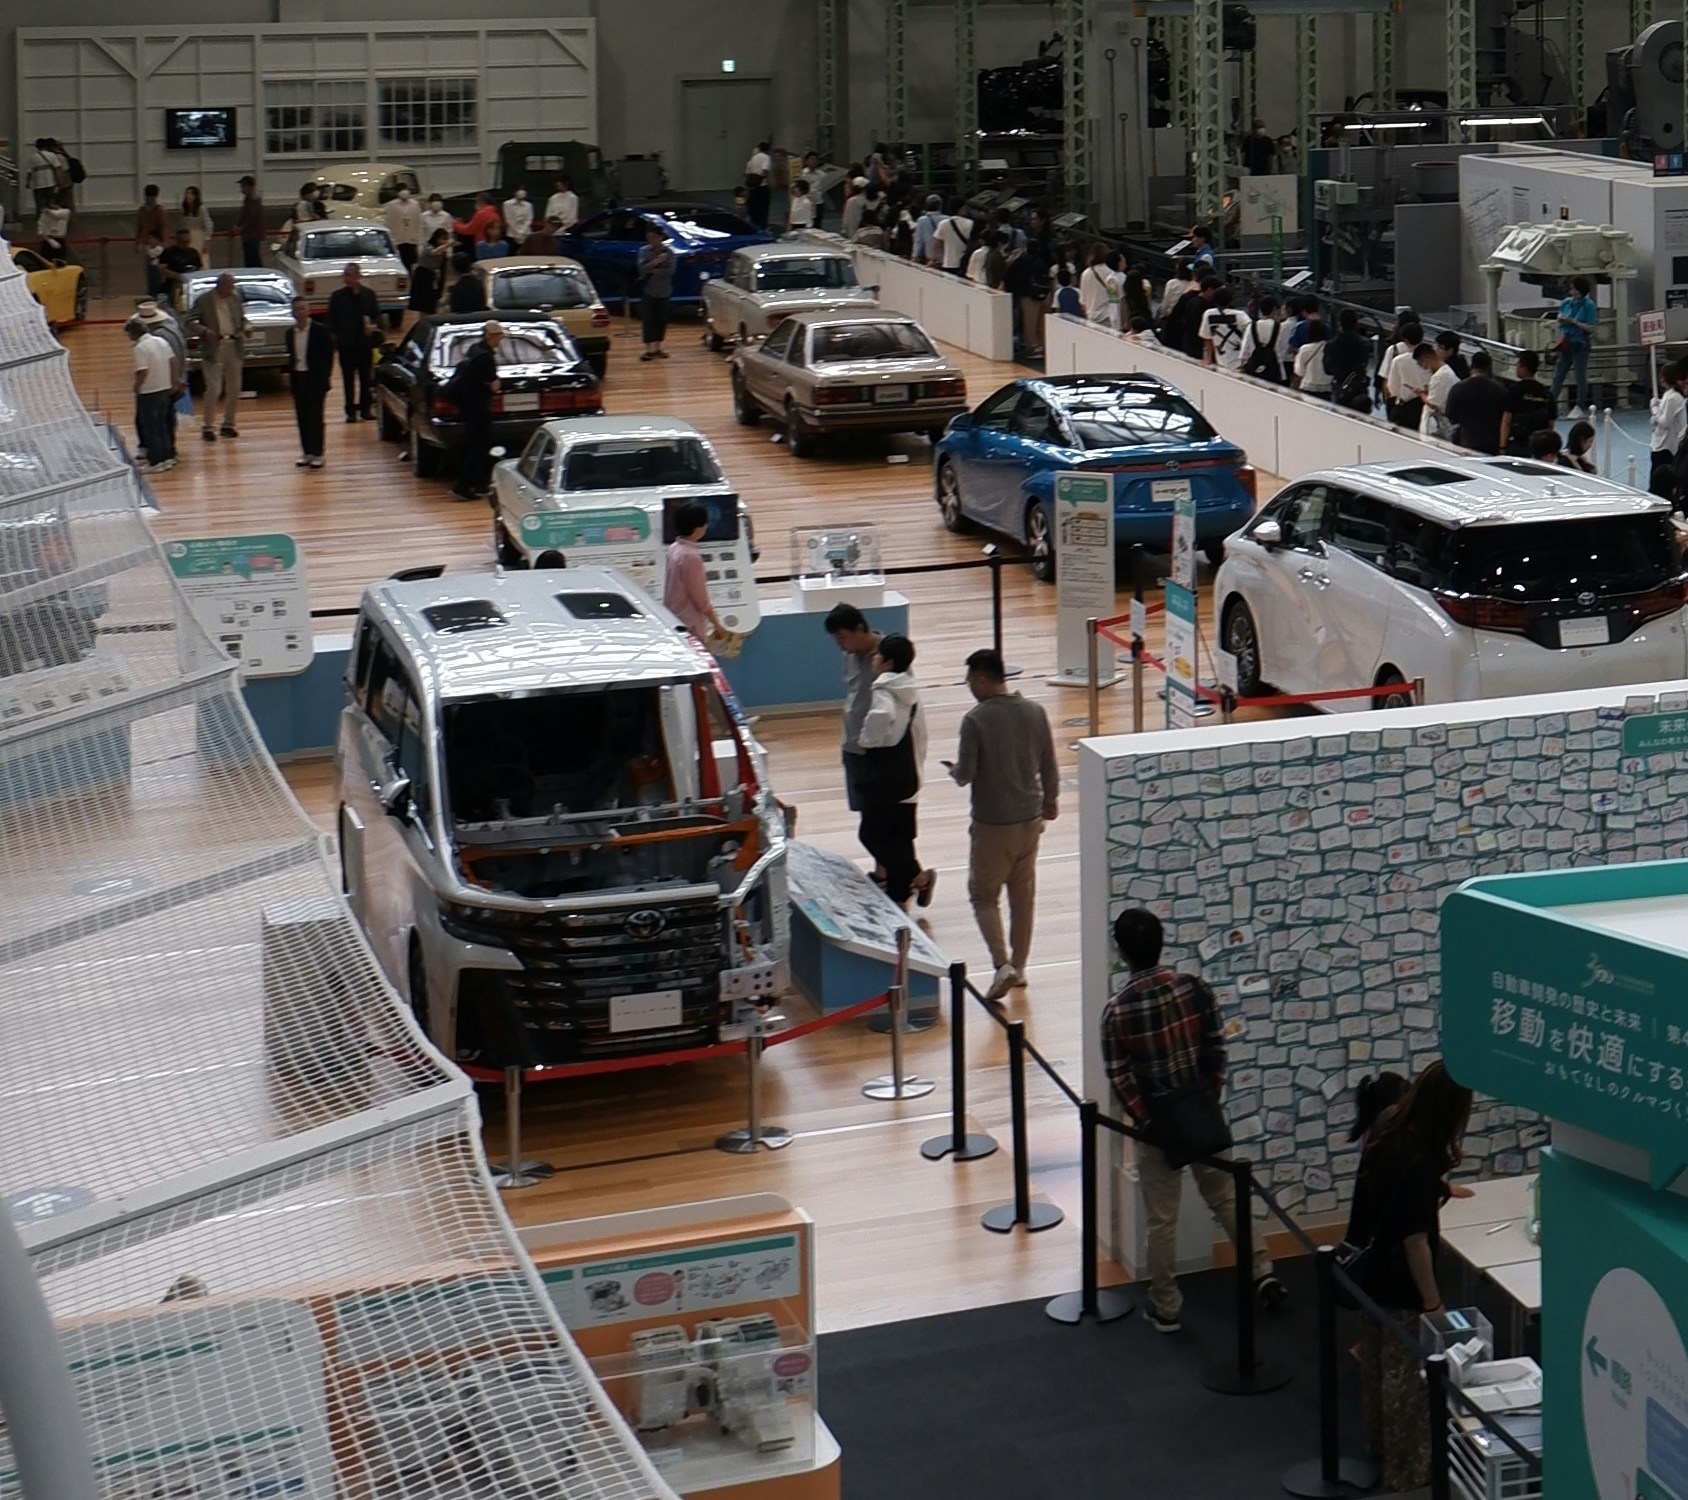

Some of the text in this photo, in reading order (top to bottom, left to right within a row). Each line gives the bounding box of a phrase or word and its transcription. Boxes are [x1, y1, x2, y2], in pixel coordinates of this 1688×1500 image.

[1492, 970, 1642, 1032] 自動車開発の歴史と未来
